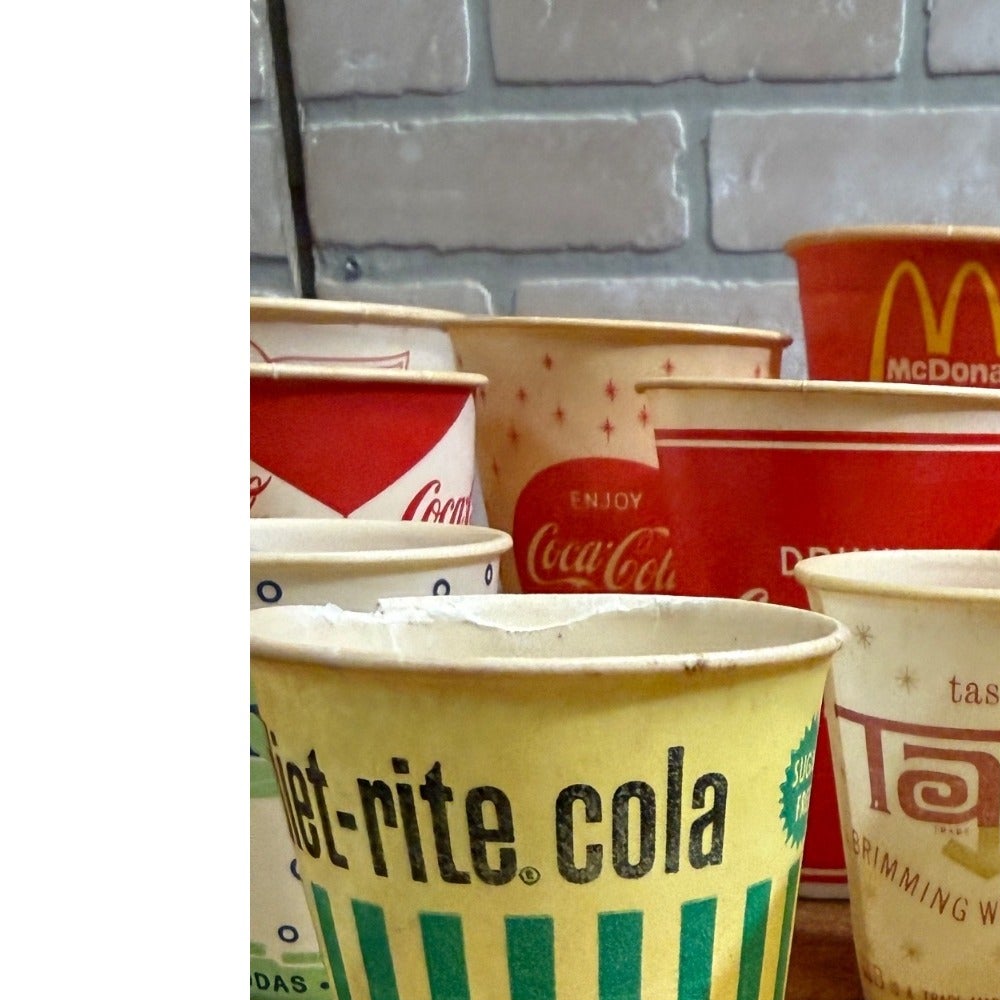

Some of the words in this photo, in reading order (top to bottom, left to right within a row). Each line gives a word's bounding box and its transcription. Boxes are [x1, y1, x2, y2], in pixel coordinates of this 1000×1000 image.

[402, 479, 471, 526] Coca
[570, 490, 642, 511] ENJOY
[270, 730, 517, 885] iet-rite
[555, 746, 728, 884] cola
[852, 829, 968, 922] BRIMMING
[250, 970, 307, 993] DAS
